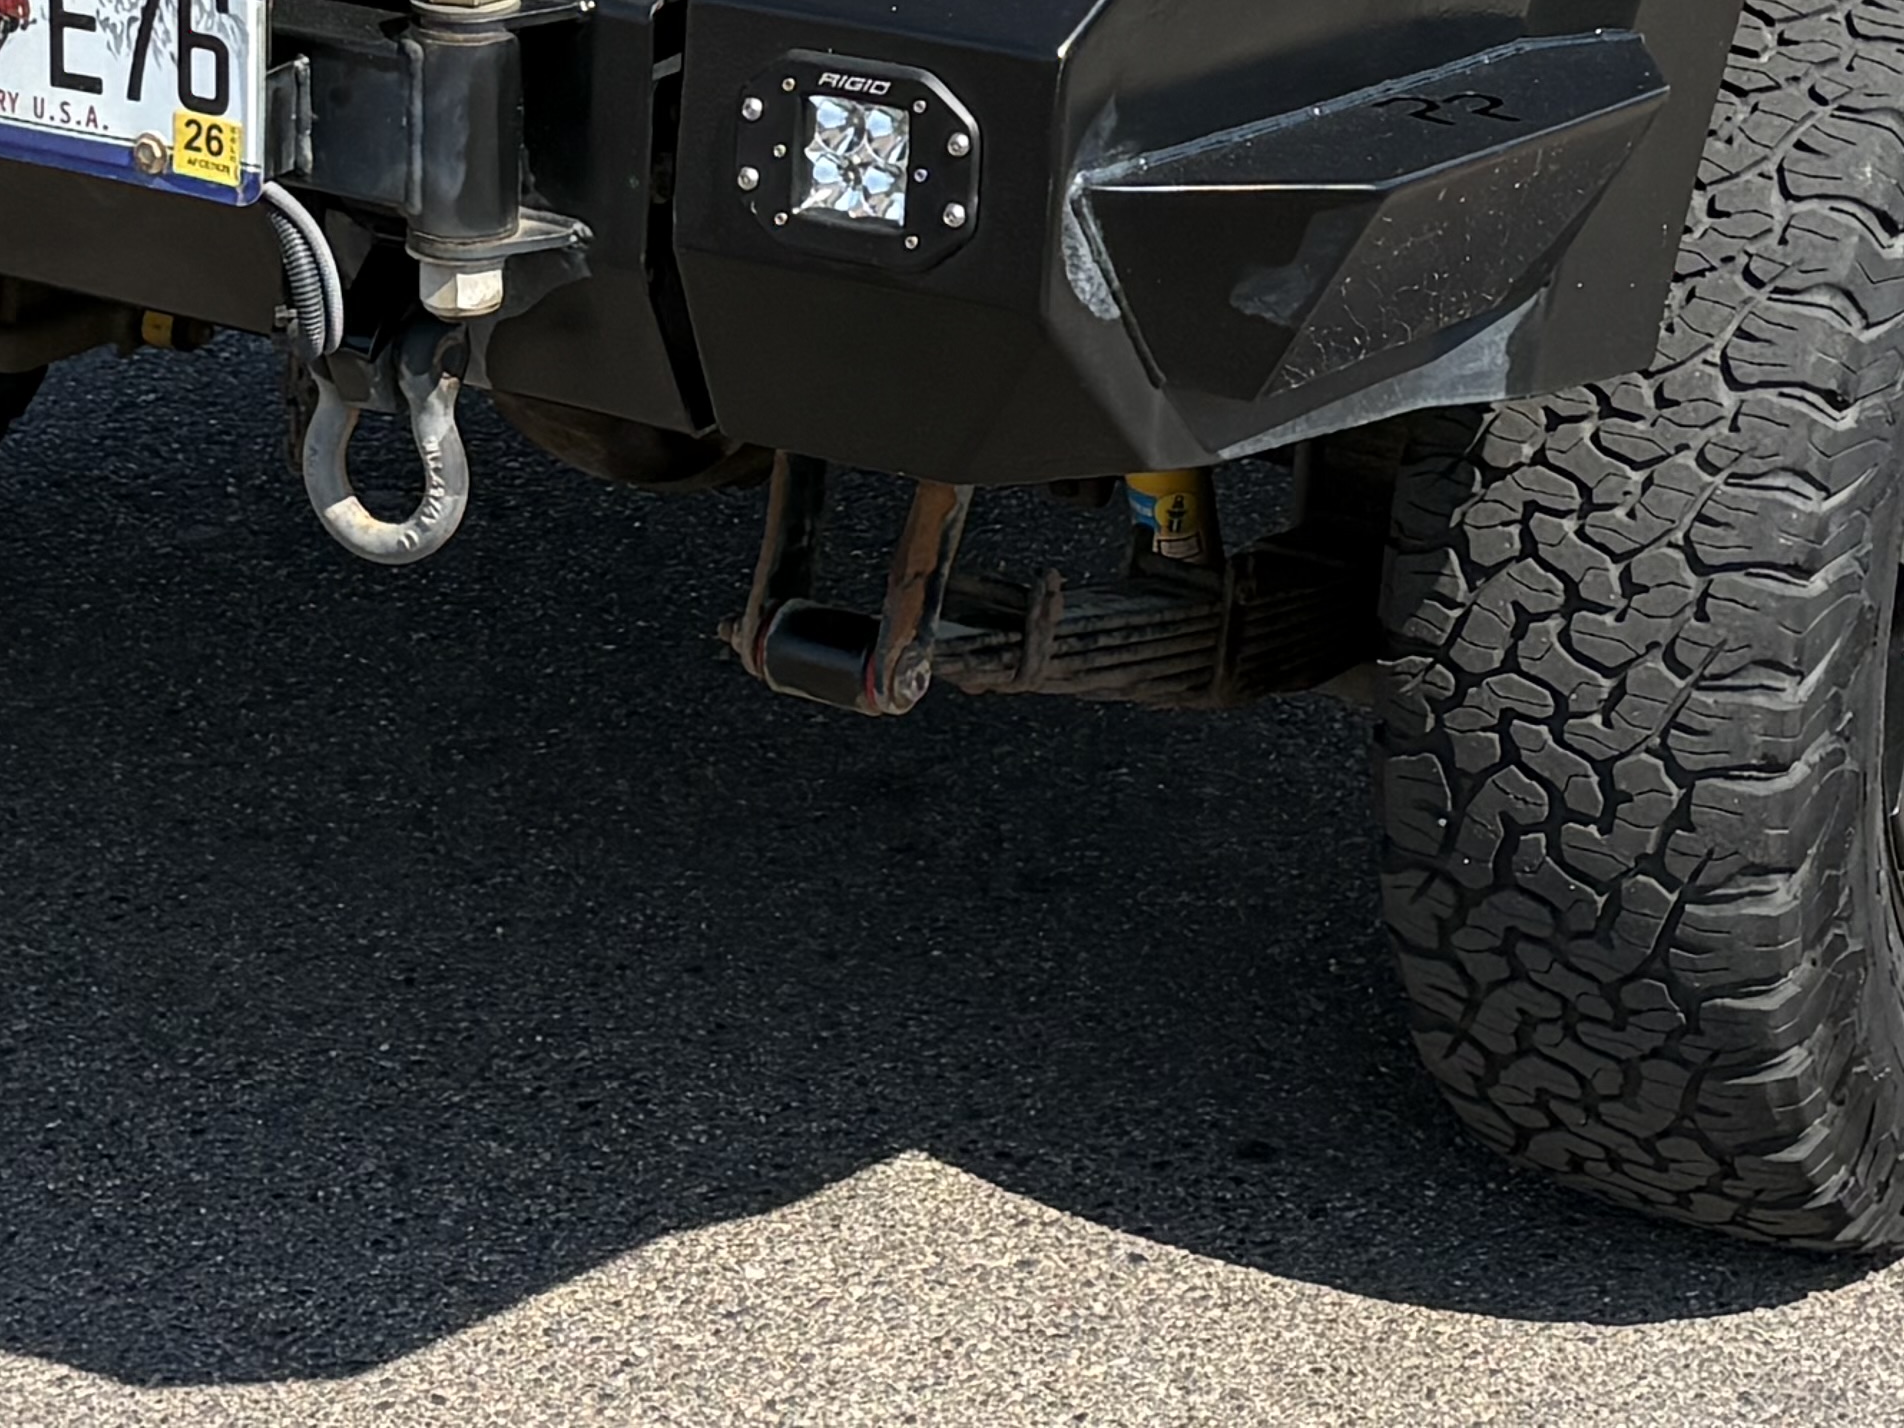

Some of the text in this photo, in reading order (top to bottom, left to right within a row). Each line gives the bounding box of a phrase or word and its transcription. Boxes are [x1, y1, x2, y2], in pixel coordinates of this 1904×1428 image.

[818, 71, 892, 96] RIGID
[33, 97, 111, 132] U.S.A.
[183, 118, 224, 158] 26
